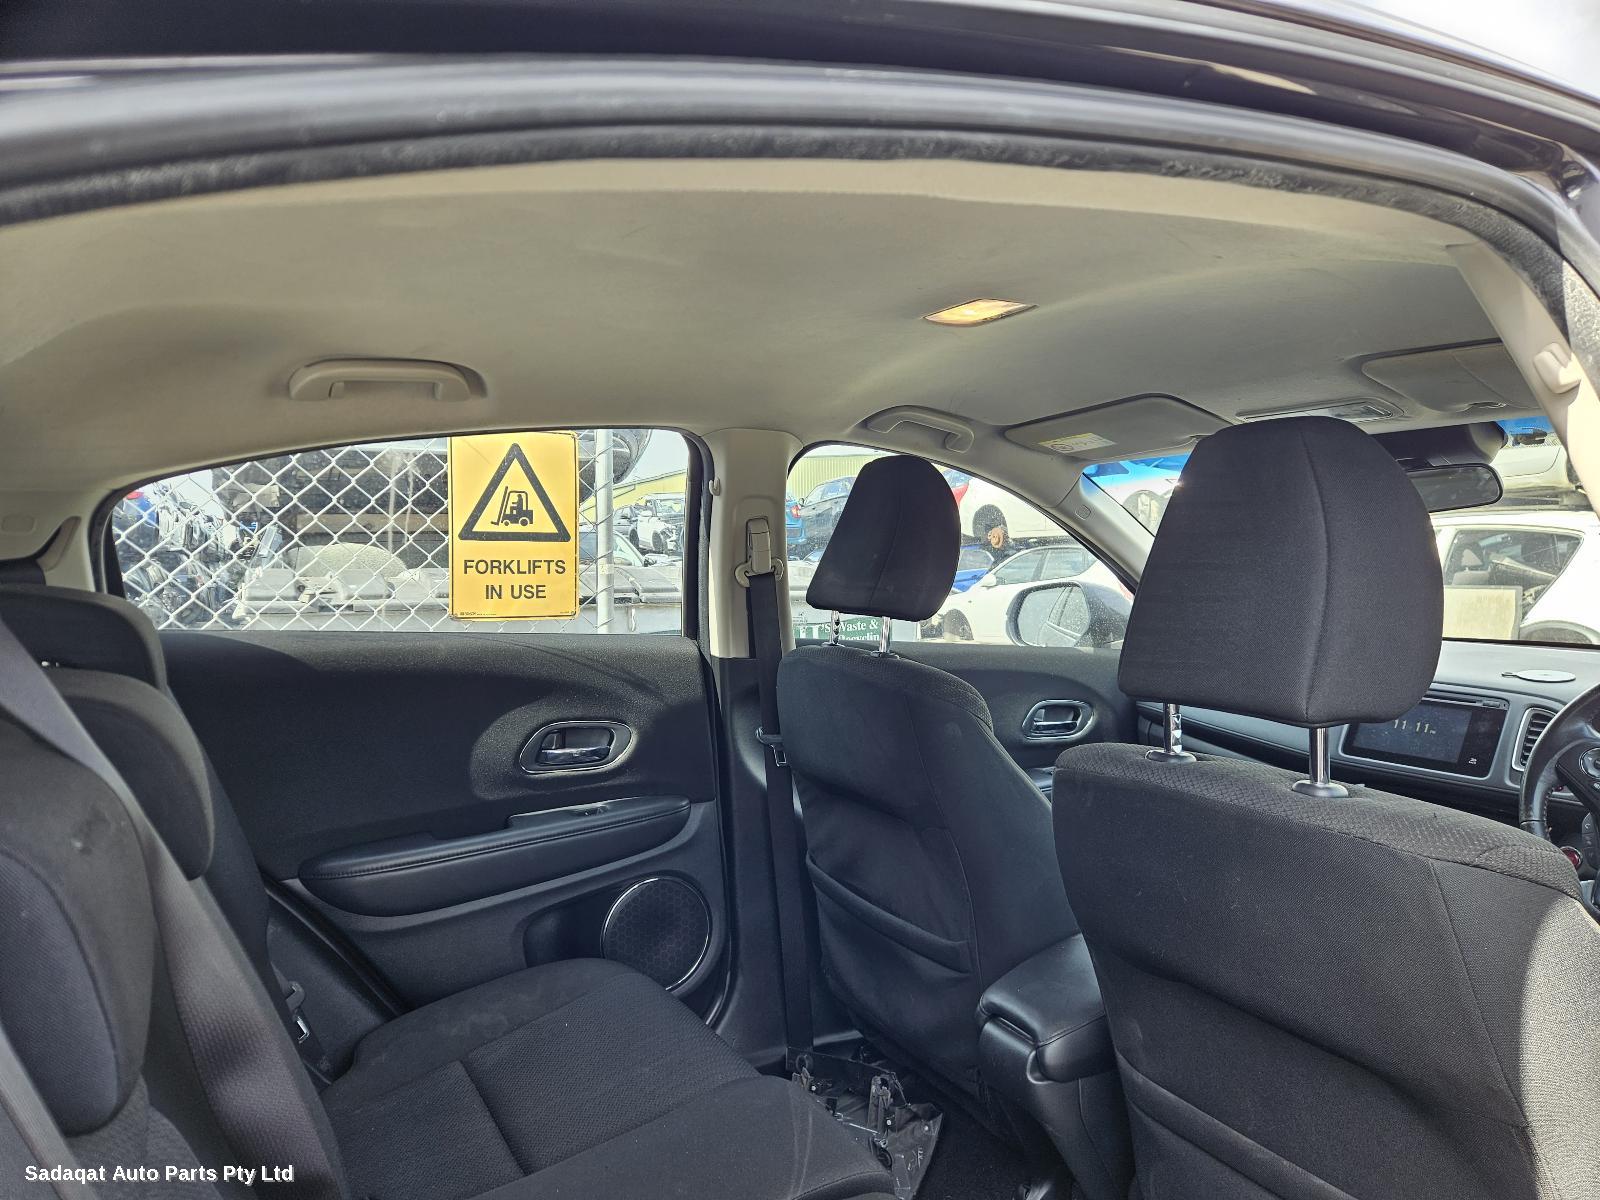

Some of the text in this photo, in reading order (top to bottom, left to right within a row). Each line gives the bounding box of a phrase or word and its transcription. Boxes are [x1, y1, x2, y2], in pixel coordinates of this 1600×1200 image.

[463, 559, 566, 575] FORKLIFTS
[485, 584, 547, 600] IN USE
[869, 619, 879, 630] &
